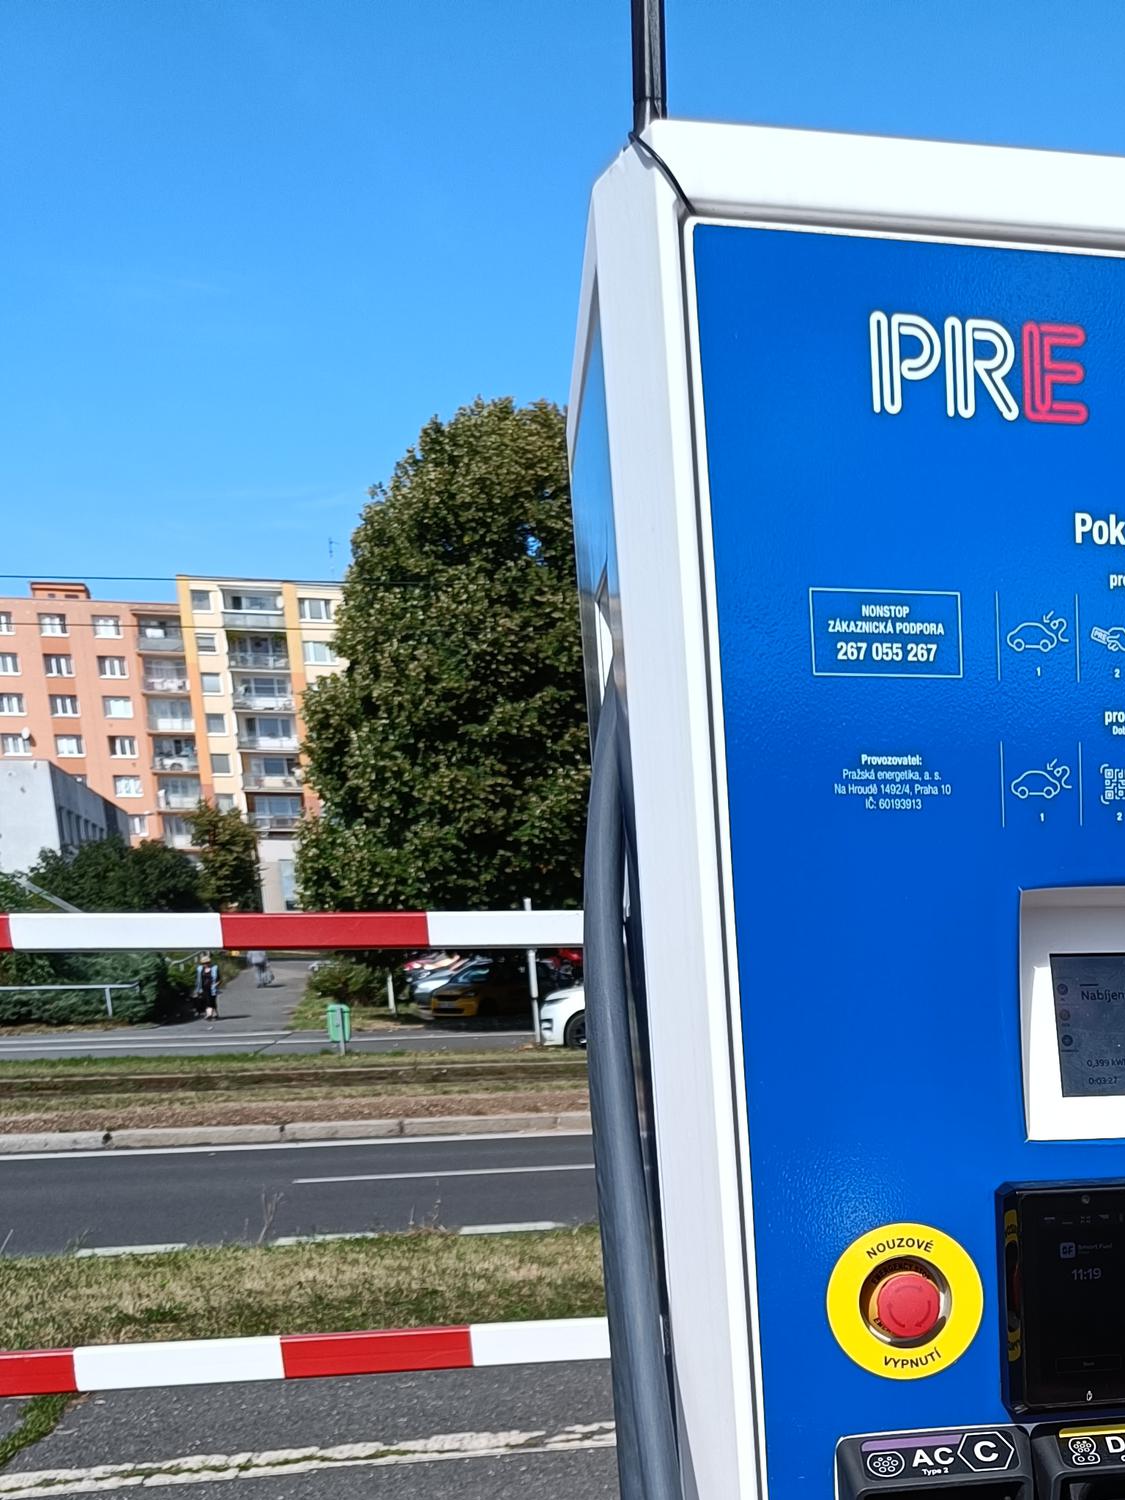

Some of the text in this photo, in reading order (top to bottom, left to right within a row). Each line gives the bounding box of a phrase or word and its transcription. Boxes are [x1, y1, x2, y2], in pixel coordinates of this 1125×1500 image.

[869, 310, 1089, 425] PRE
[861, 604, 909, 618] NONSTOP
[828, 618, 944, 636] ZÁKAZNICKÁ PODPORA
[836, 642, 937, 662] 267 055 267
[1036, 666, 1042, 677] 1
[1114, 669, 1120, 678] 2
[1105, 711, 1125, 725] pro
[861, 754, 922, 766] Provozovatel:
[843, 769, 941, 782] Pražská energetika, a. s.
[834, 784, 951, 796] Na Hroudě 1492/4, Praha 10
[879, 799, 921, 809] 60193913
[1040, 812, 1045, 822] 1
[1117, 812, 1122, 821] 2
[866, 1237, 934, 1259] NOUZOVÉ
[1072, 1268, 1102, 1280] 11:19
[884, 1347, 942, 1368] VYPNUTÍ
[912, 1446, 954, 1467] AC
[974, 1440, 999, 1462] C
